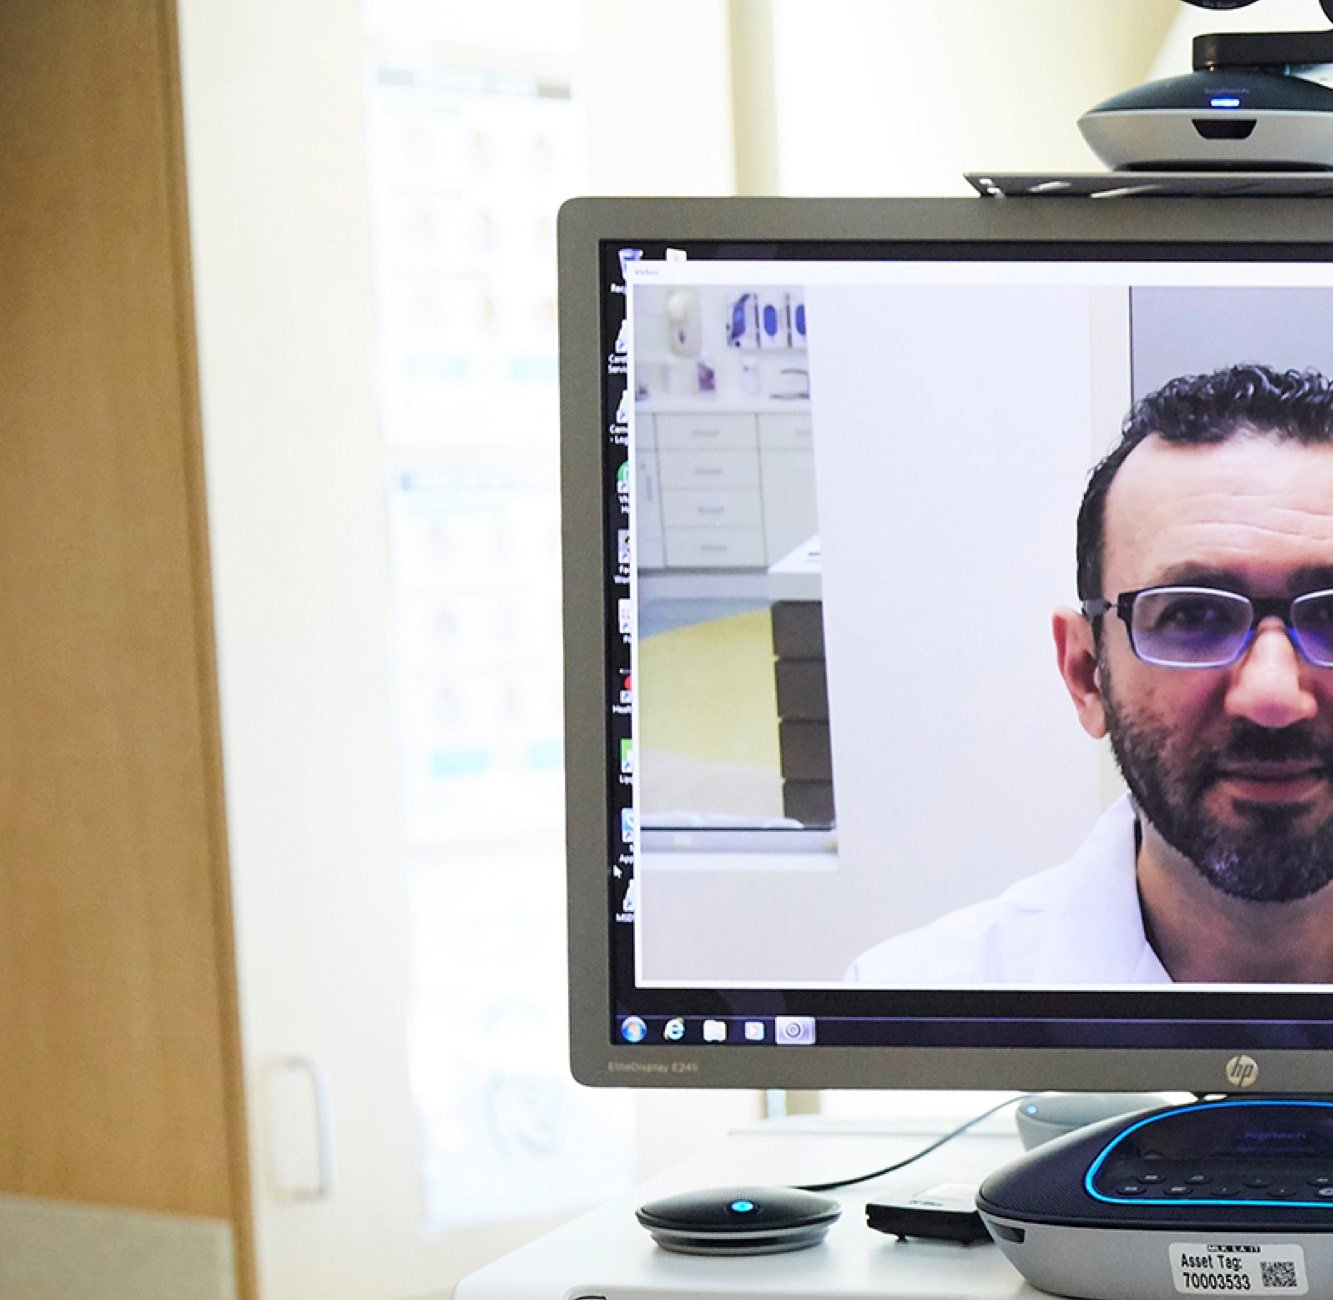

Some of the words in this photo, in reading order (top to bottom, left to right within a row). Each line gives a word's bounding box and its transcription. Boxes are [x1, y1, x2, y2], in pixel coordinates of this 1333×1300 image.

[608, 1061, 668, 1074] EliteDisplay
[1229, 1055, 1256, 1087] hp
[1181, 1253, 1214, 1269] Asset
[1217, 1255, 1243, 1271] Tag:
[1182, 1272, 1250, 1290] 70003533
